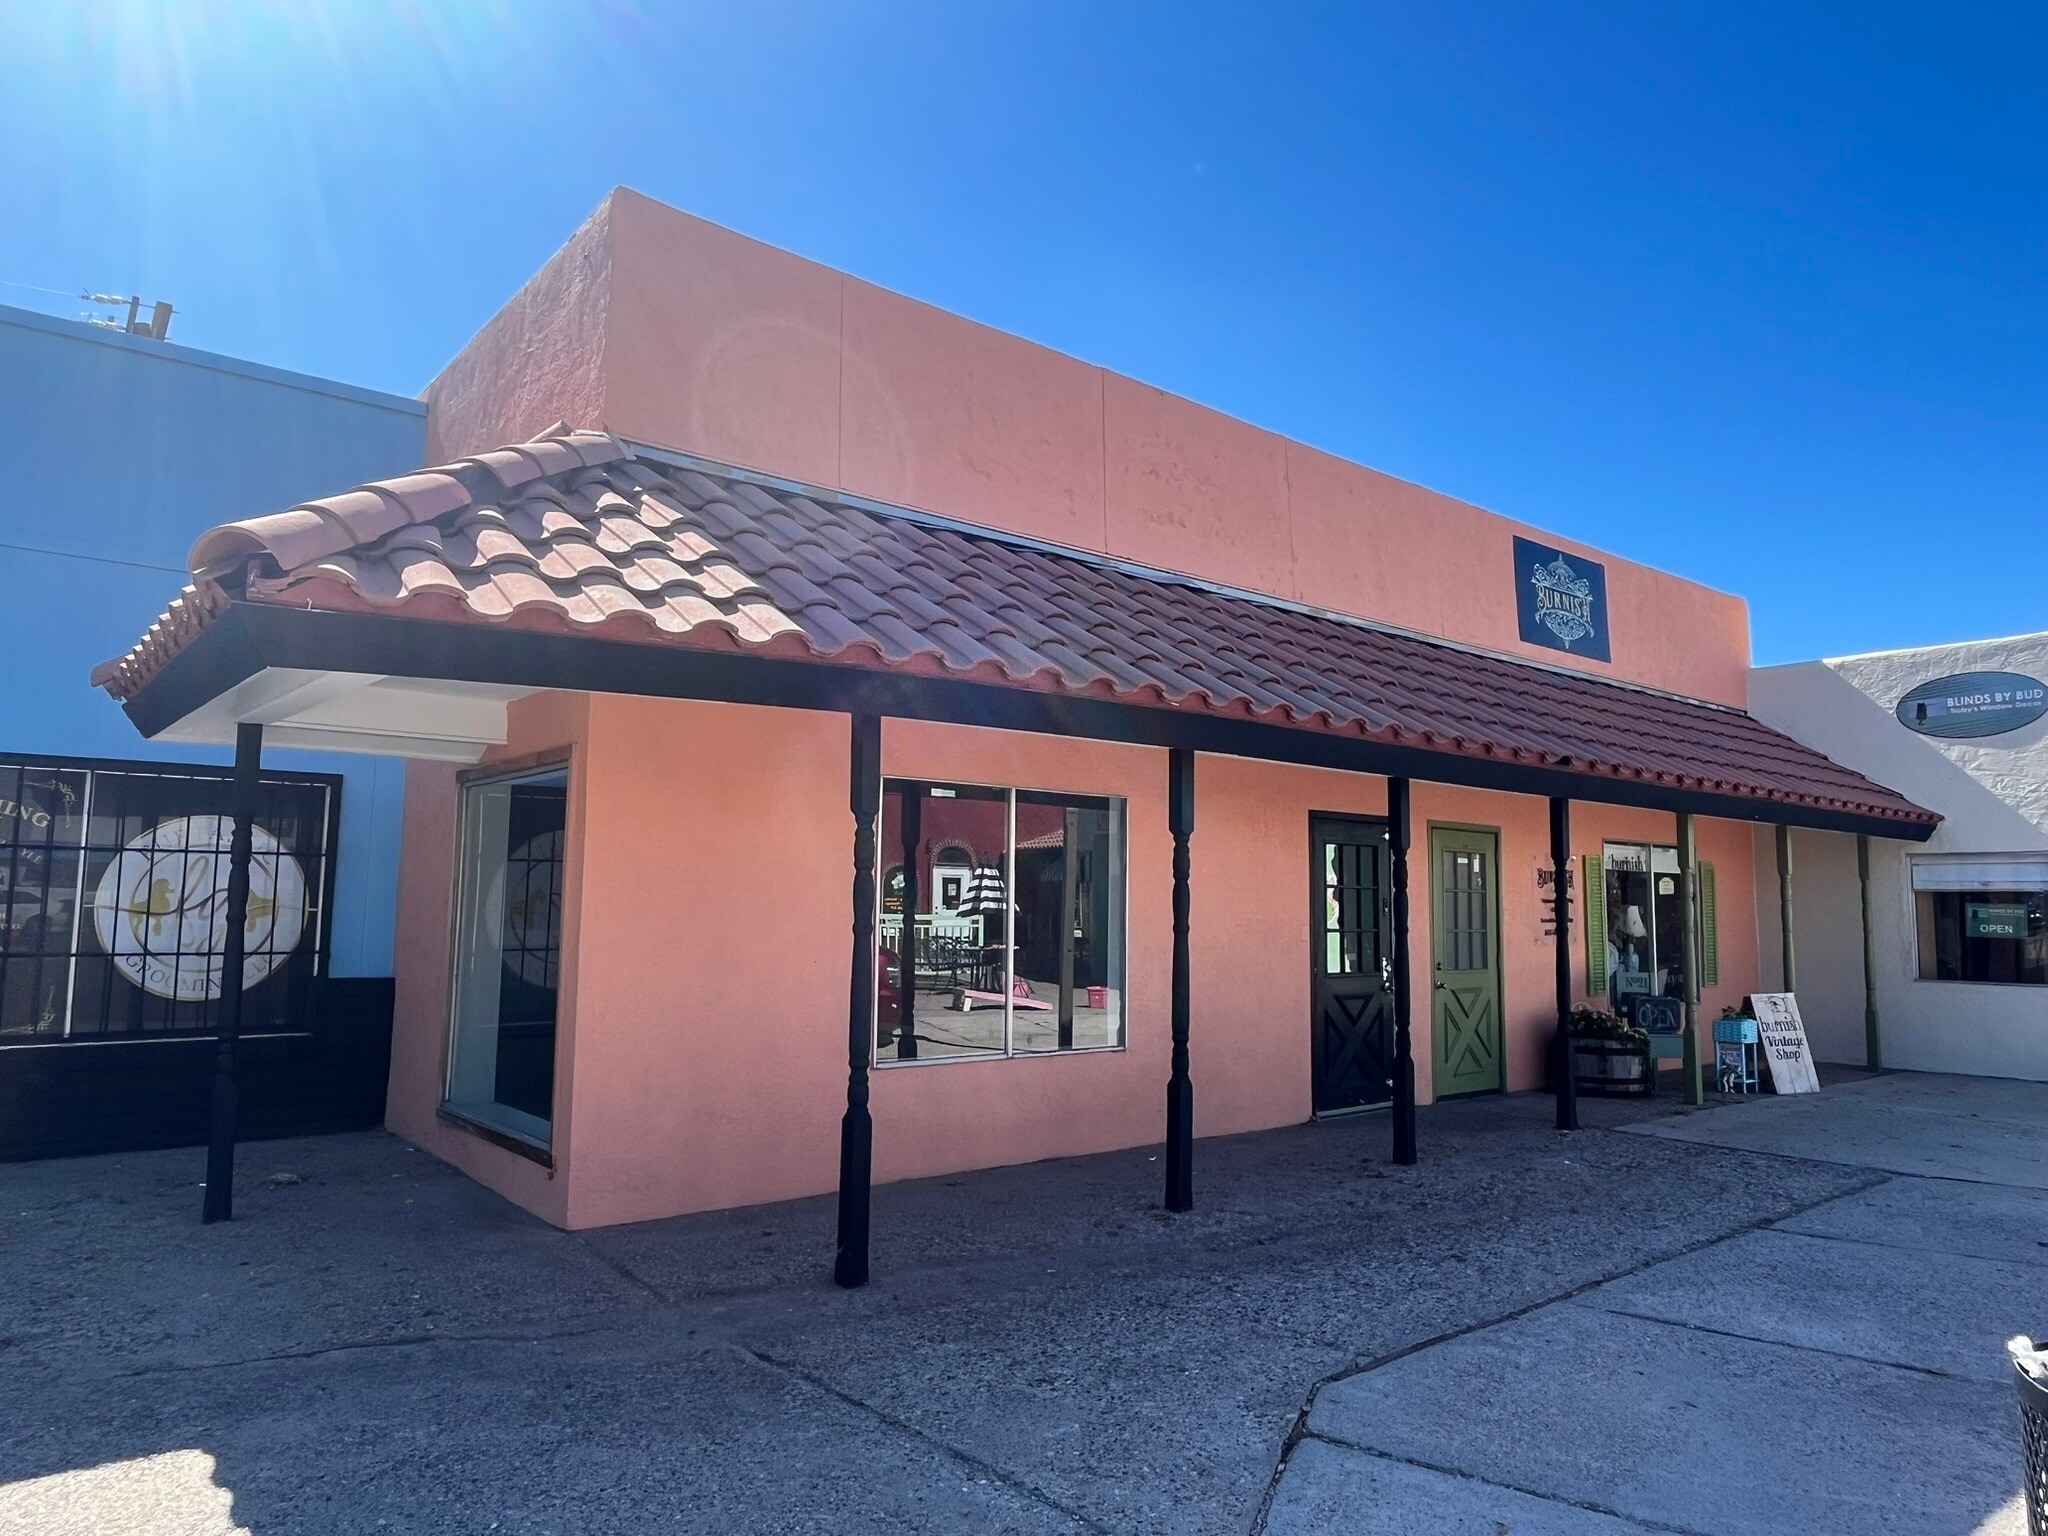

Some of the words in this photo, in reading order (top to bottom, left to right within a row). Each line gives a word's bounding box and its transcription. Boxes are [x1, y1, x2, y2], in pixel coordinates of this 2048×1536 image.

[1536, 584, 1592, 624] BURNISH
[1947, 693, 1991, 707] BLINDS
[1995, 691, 2011, 702] BY
[2015, 689, 2044, 700] BUD
[1980, 703, 2013, 711] Window
[1980, 925, 2013, 933] OPEN
[1639, 1003, 1676, 1030] OPEN
[1759, 1016, 1802, 1032] burnish
[1764, 1035, 1805, 1049] Vintage
[1776, 1046, 1801, 1064] Shop
